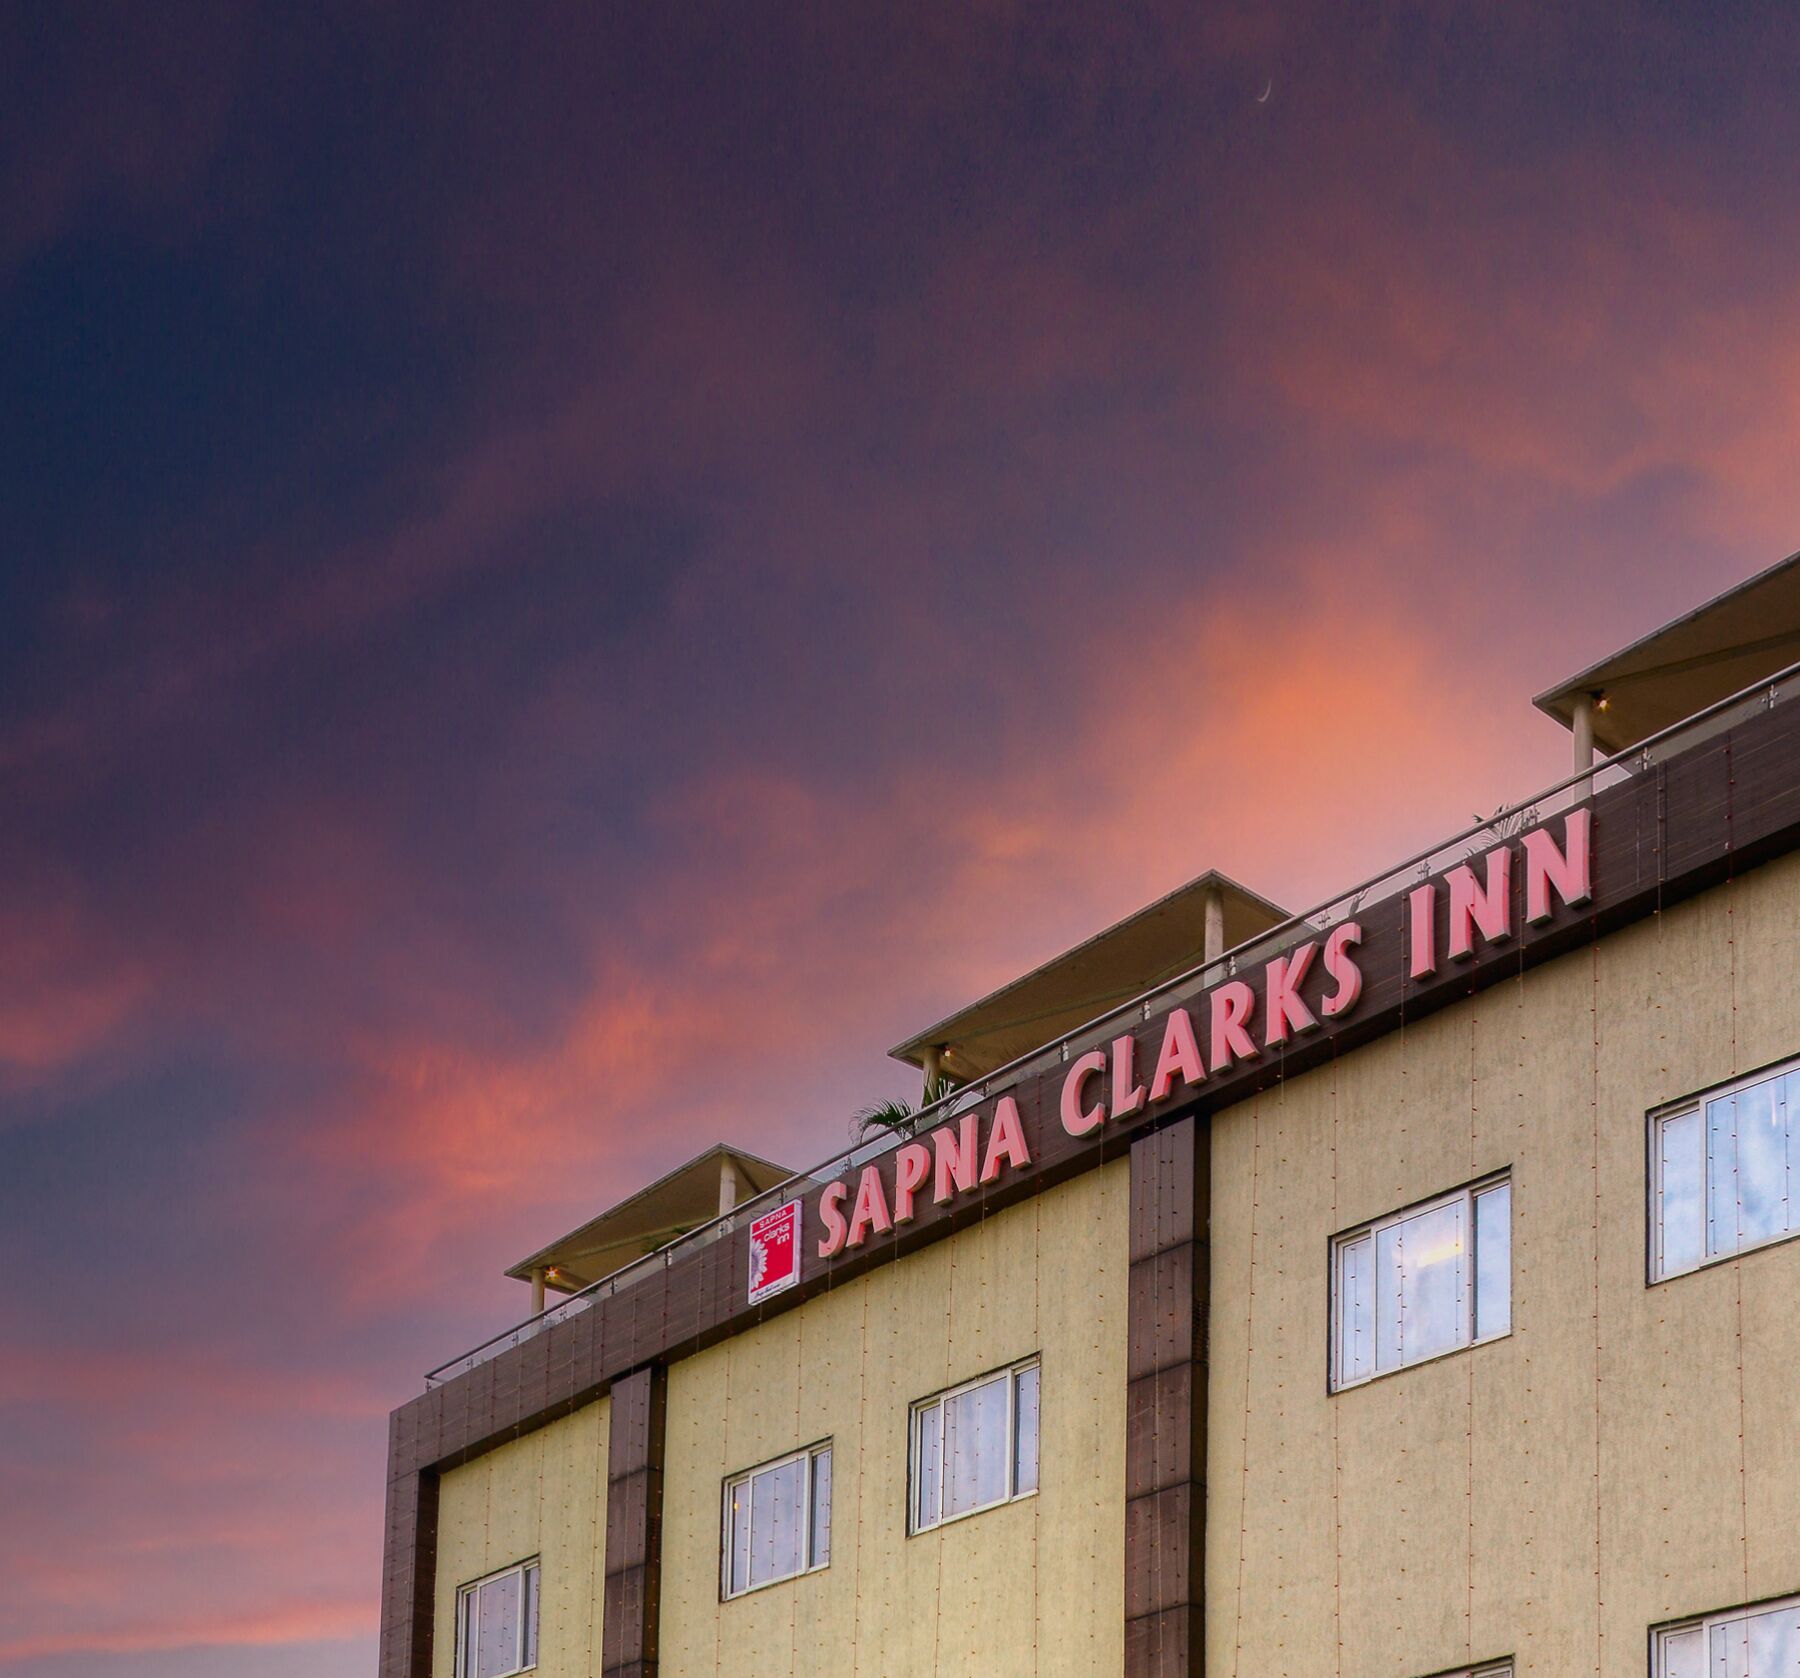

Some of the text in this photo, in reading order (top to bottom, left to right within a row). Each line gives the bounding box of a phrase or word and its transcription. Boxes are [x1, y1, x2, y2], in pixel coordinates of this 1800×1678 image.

[818, 807, 1592, 1259] SAPNA CLARKS INN
[760, 1210, 787, 1229] SAPNA
